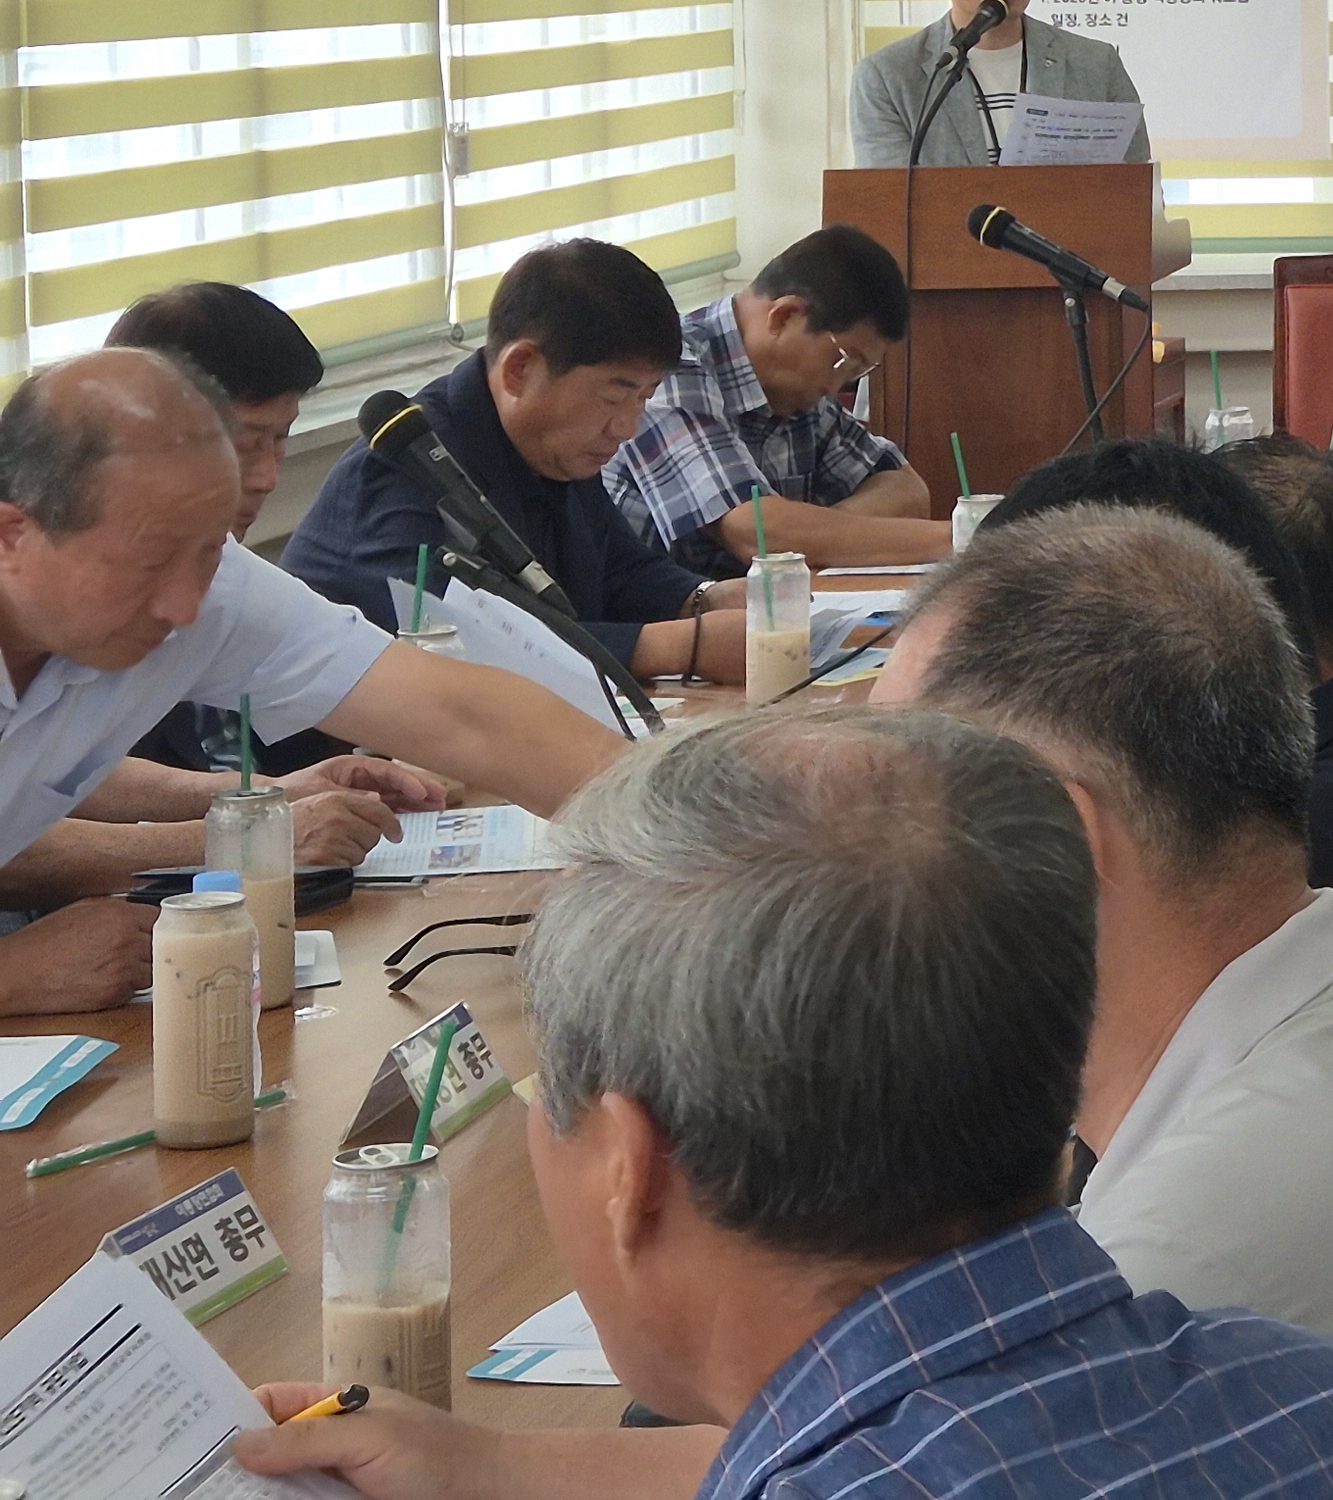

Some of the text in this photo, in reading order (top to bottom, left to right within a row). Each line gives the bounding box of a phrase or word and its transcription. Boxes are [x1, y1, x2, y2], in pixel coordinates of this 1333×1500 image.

[1084, 13, 1113, 28] 장소
[1115, 12, 1129, 27] 건
[456, 1031, 495, 1081] 총무
[214, 1203, 267, 1263] 총무
